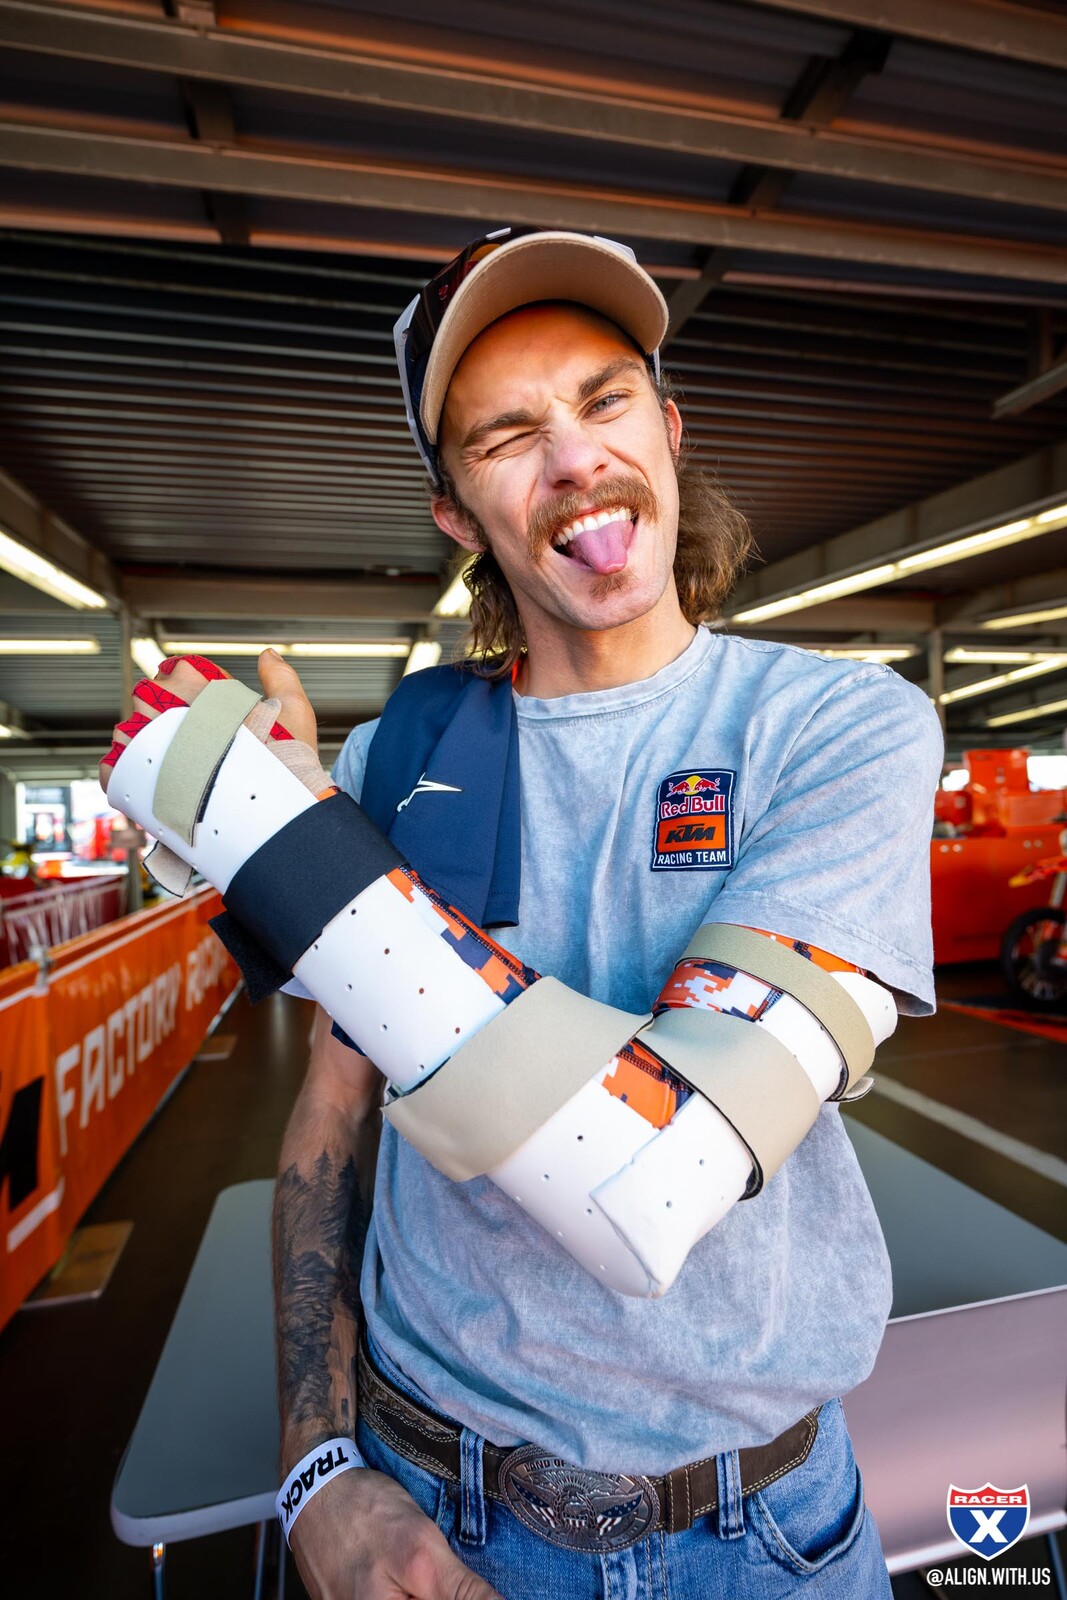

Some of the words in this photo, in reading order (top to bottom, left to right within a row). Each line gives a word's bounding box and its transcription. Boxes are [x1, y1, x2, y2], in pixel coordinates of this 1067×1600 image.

[661, 796, 690, 819] Red
[690, 794, 726, 813] Bull
[664, 823, 716, 844] KTM
[657, 852, 692, 865] RACING
[696, 850, 727, 863] TEAM
[56, 961, 182, 1157] FACTORY
[524, 1459, 550, 1473] LAND
[281, 1446, 349, 1524] TRACK
